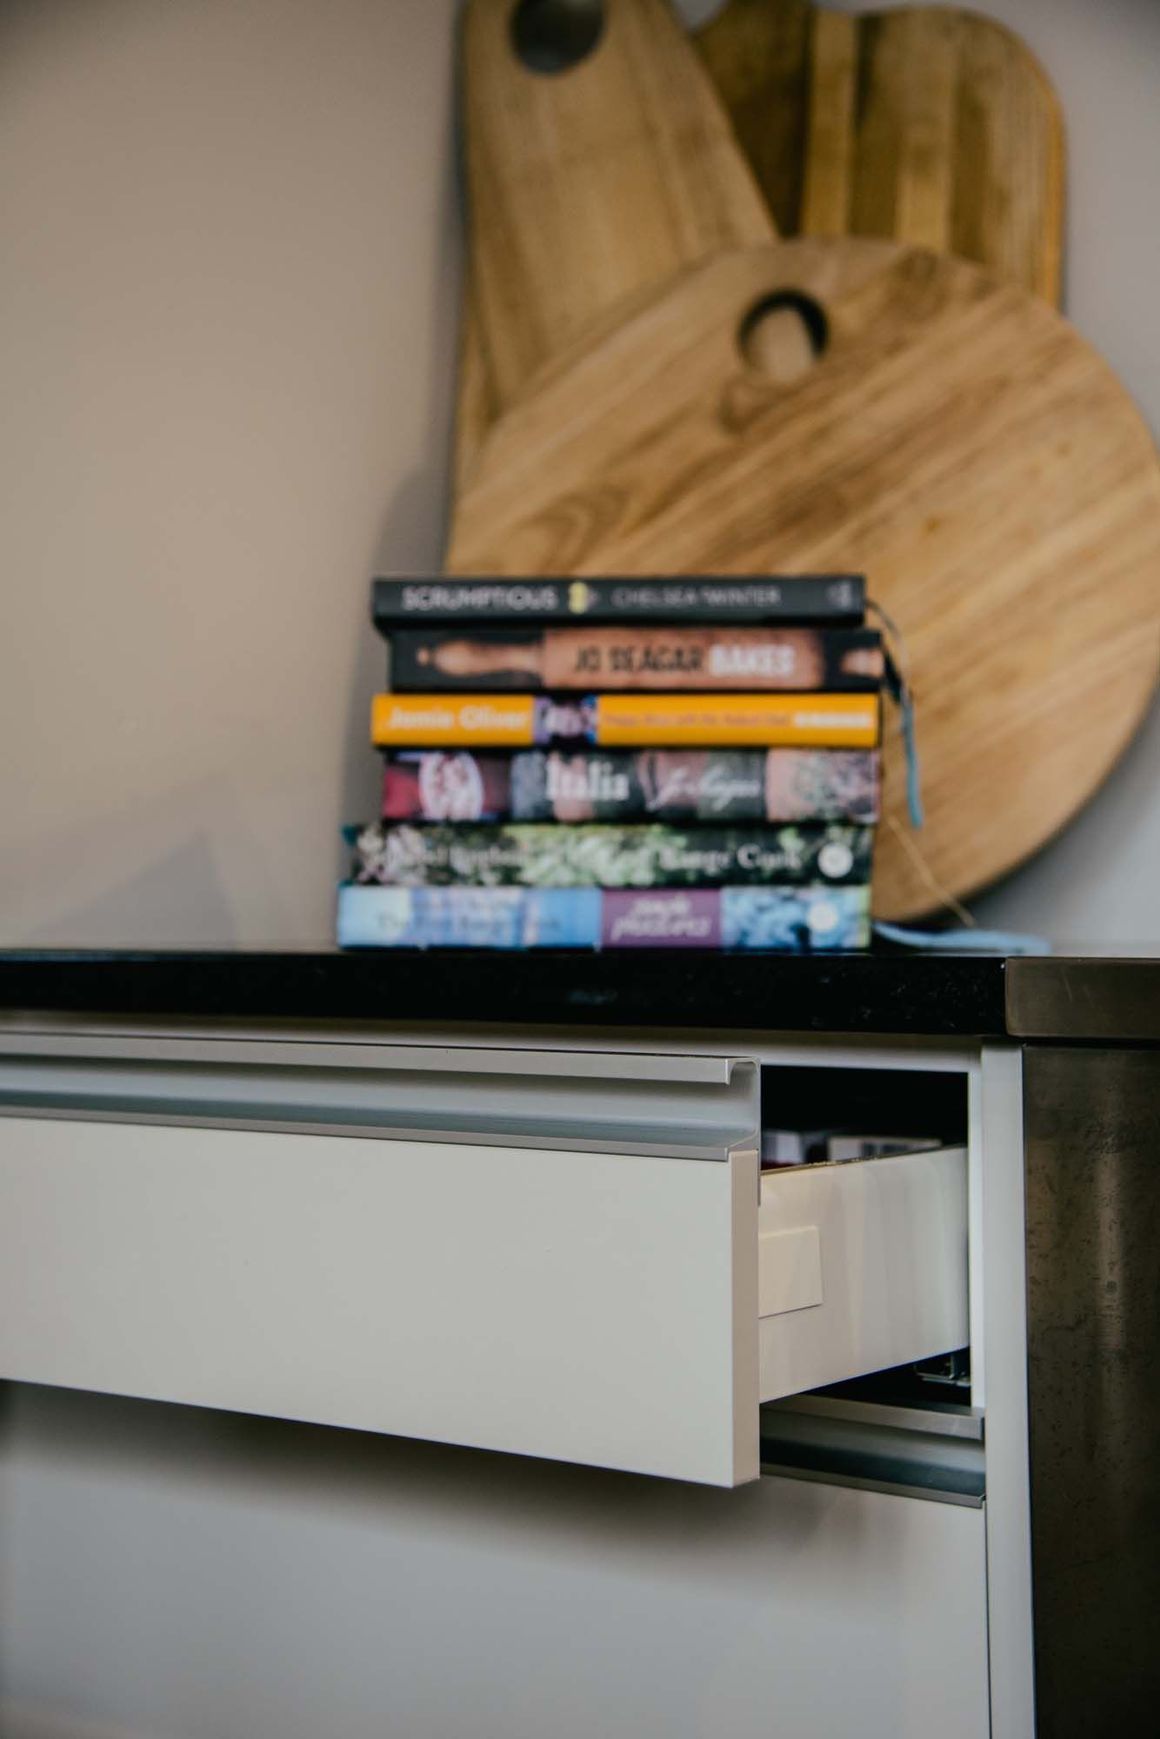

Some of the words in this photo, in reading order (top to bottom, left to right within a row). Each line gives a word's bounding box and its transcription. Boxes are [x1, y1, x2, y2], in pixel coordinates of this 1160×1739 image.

[401, 585, 558, 610] SCRUMPTIOUS
[709, 645, 795, 676] BAKES
[388, 706, 455, 730] Jamie
[459, 705, 529, 731] Oliver
[545, 760, 629, 801] Italia
